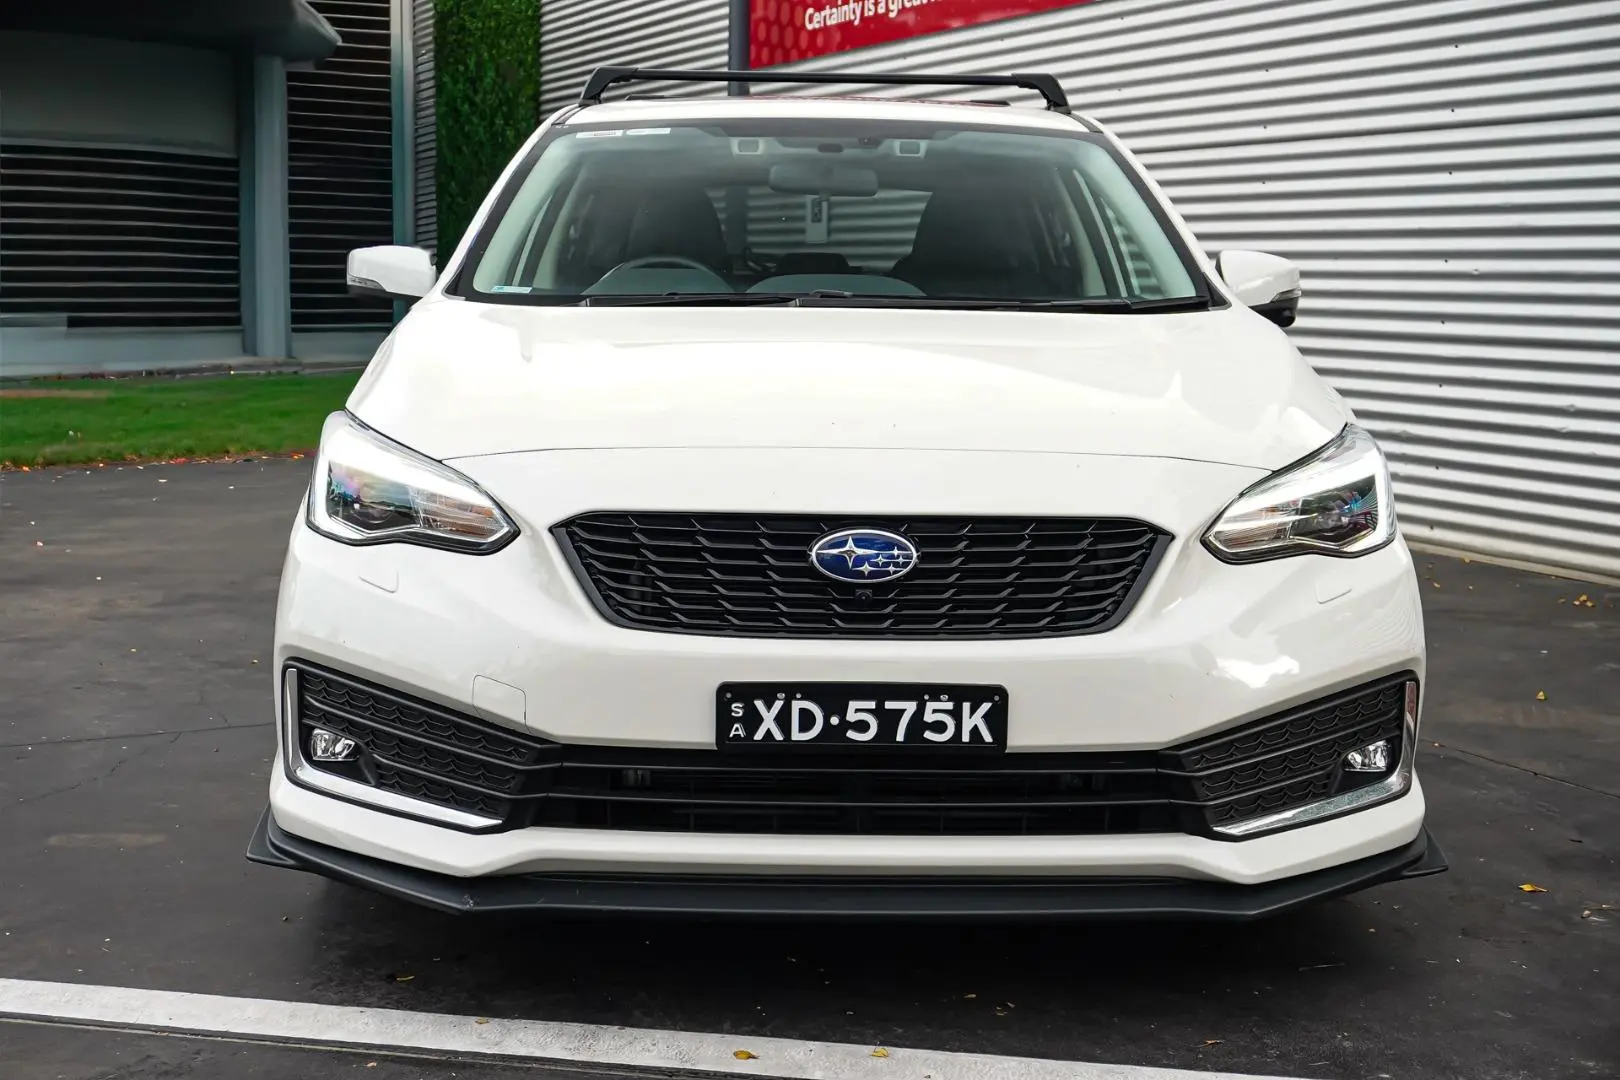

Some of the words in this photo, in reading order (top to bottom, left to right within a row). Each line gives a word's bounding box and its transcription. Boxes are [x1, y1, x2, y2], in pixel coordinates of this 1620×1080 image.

[804, 0, 862, 30] Certainty
[864, 0, 875, 17] is
[877, 0, 886, 14] a
